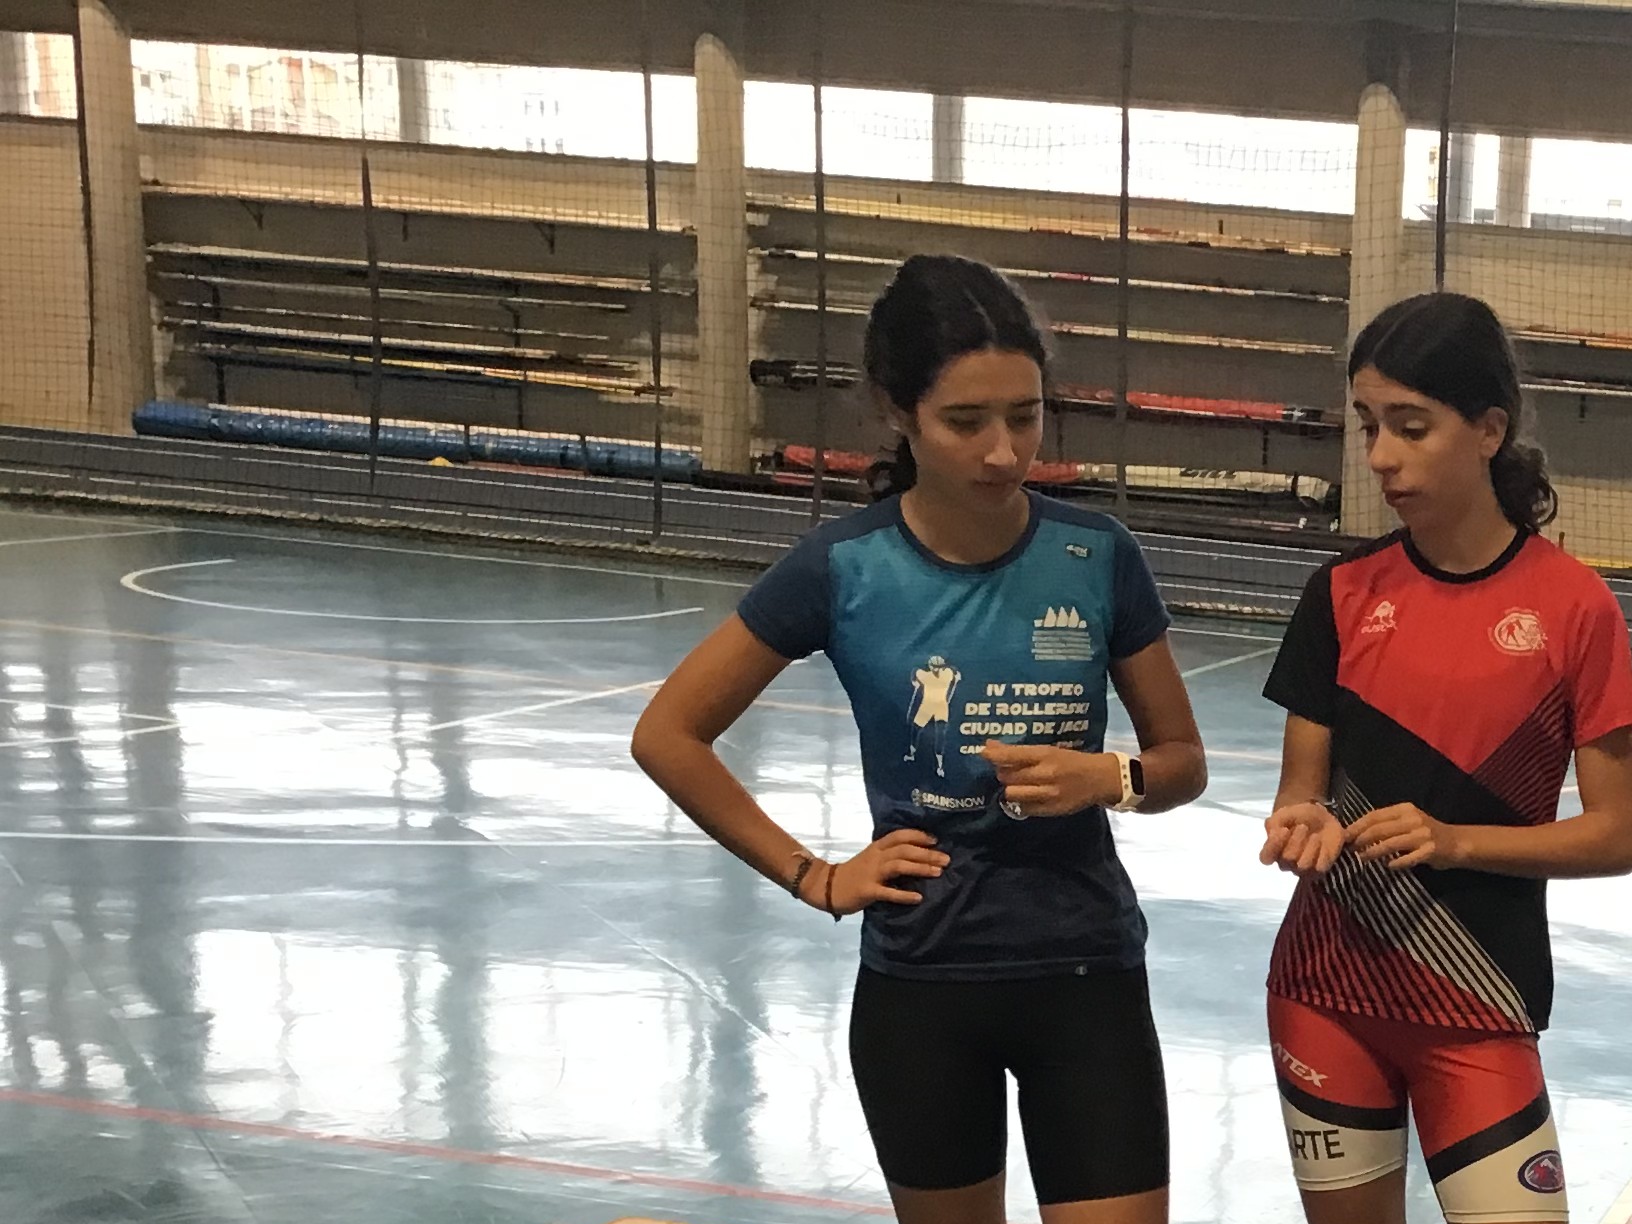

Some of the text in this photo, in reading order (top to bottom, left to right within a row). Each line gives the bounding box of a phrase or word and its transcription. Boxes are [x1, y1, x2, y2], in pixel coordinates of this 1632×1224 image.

[986, 683, 1084, 697] IV TROFEO
[964, 702, 1090, 716] DE ROLLERSKI
[959, 719, 1090, 736] CIUDAD DE JACA
